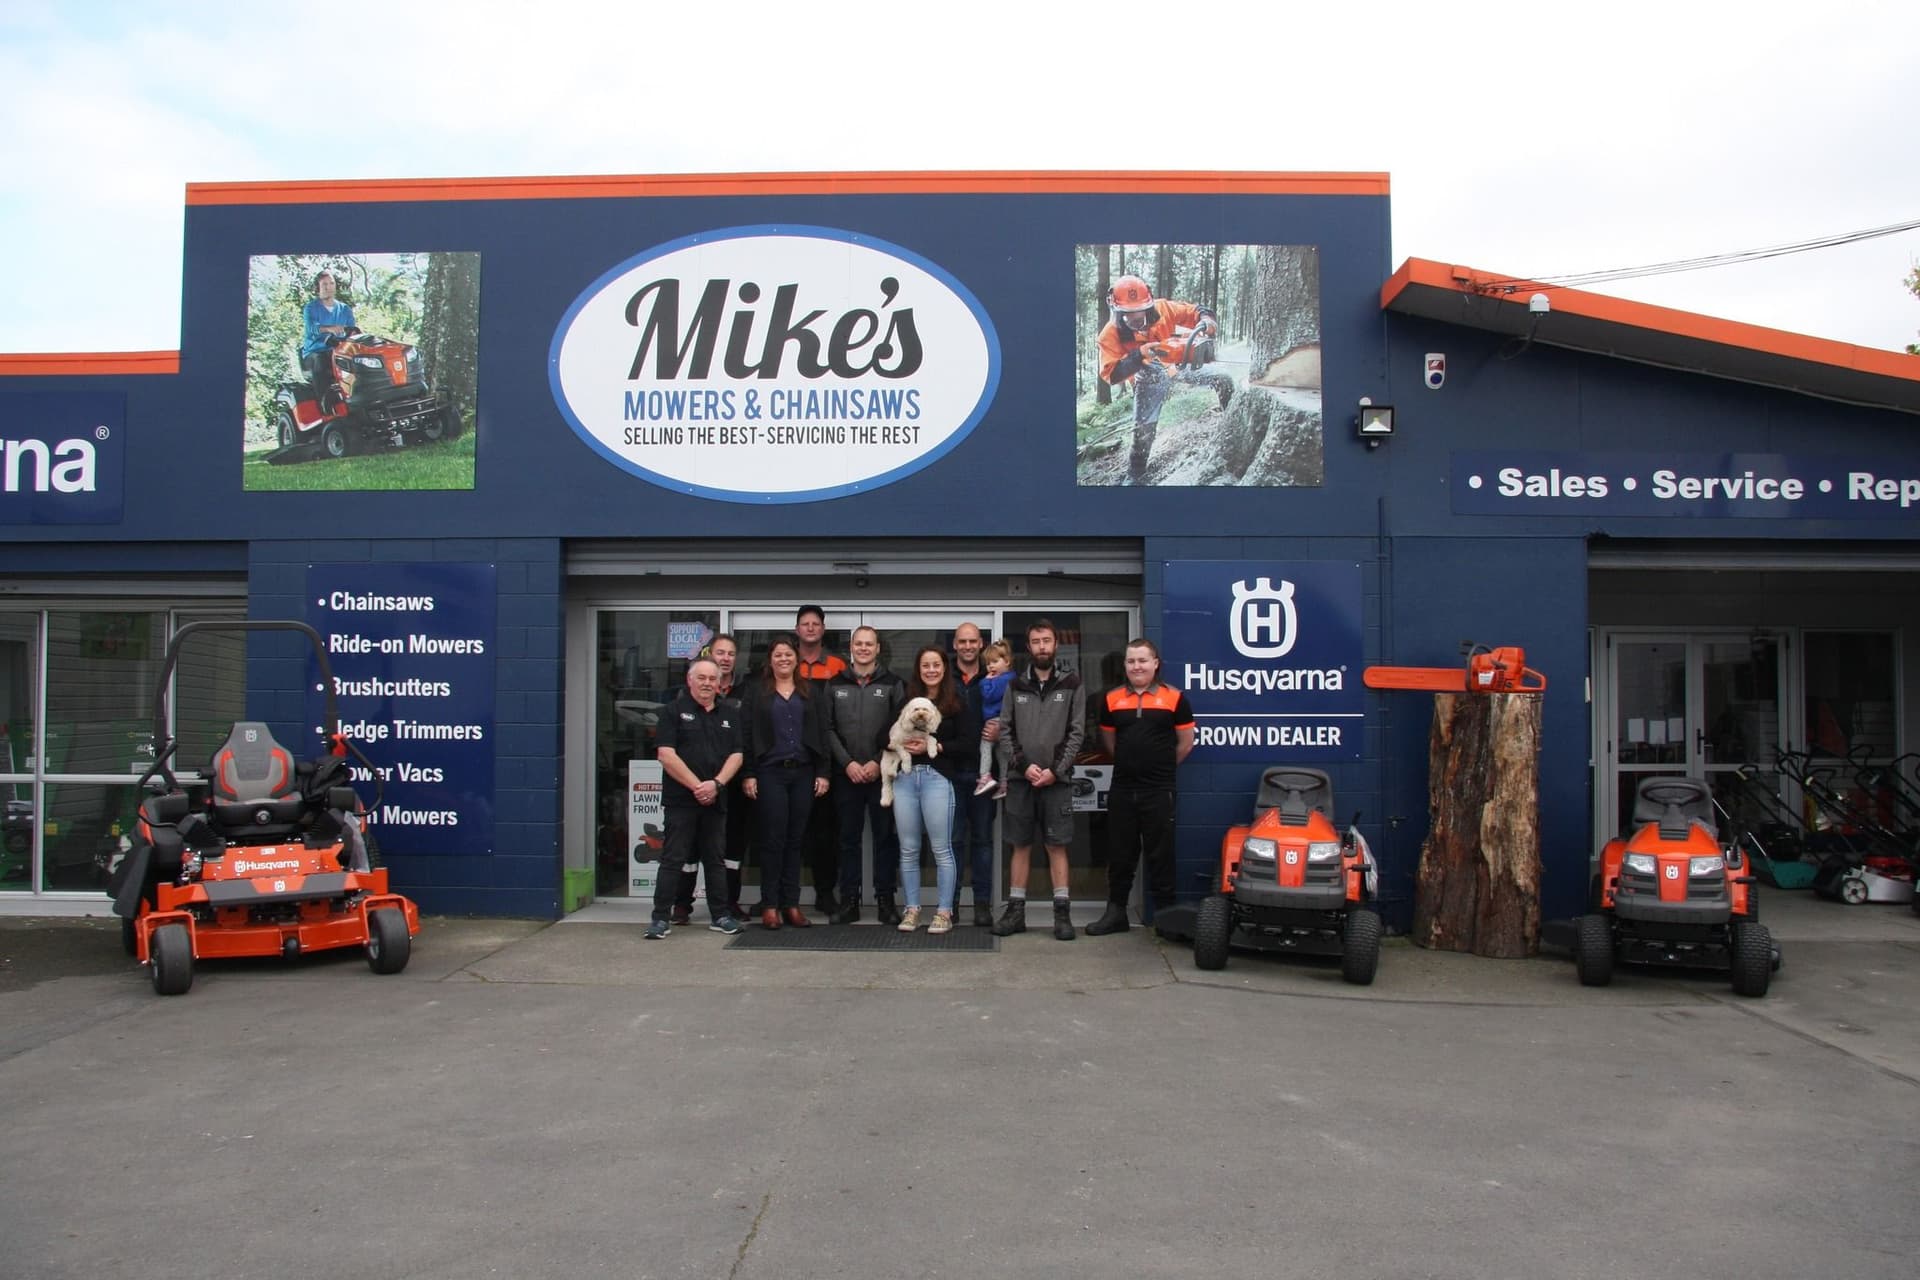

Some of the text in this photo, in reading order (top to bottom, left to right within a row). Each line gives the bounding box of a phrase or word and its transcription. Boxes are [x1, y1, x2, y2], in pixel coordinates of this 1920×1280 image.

[625, 276, 924, 380] Mike's
[624, 388, 921, 420] MOWERS & CHAINSAWS
[624, 427, 684, 445] SELLING
[688, 427, 715, 445] THE
[850, 426, 878, 444] THE
[882, 426, 921, 444] REST
[1498, 468, 1608, 498] Sales
[1652, 470, 1804, 500] Service
[330, 592, 434, 611] Chainsaws
[330, 634, 484, 654] Ride-on Mowers
[670, 634, 699, 643] LOCAL
[1184, 663, 1343, 695] Husqvarna
[393, 720, 483, 740] Trimmers
[1267, 726, 1341, 746] DEALER
[398, 763, 444, 783] Vacs
[633, 793, 660, 803] LAWN
[383, 805, 458, 826] Mowers
[633, 804, 659, 814] FROM
[246, 860, 299, 870] Husqvarna
